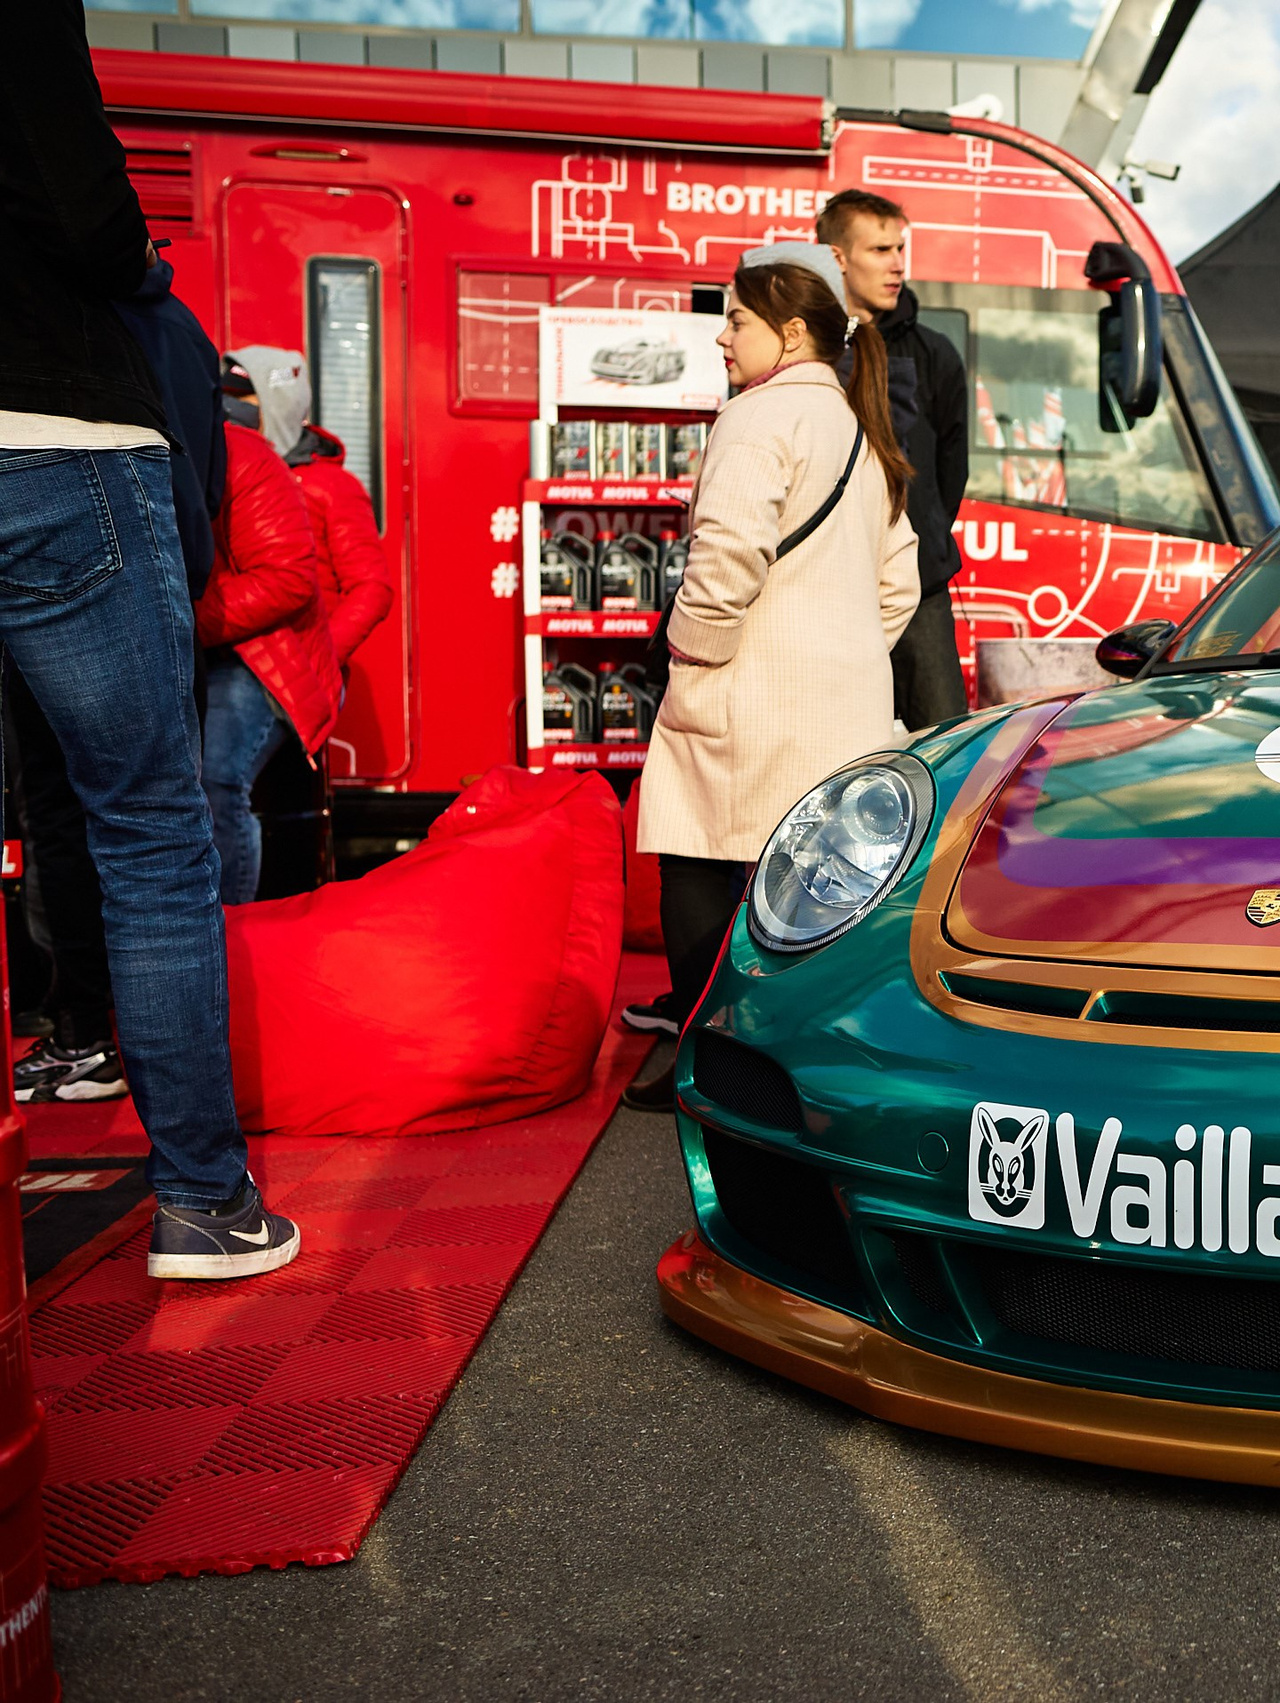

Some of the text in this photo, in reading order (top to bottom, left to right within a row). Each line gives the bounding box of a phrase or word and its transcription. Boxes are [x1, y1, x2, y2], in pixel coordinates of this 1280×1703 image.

[547, 486, 594, 500] MOTUL
[602, 487, 649, 500] MOTUL
[547, 619, 649, 633] MOTUL MOTUL
[552, 752, 598, 765] MOTUL
